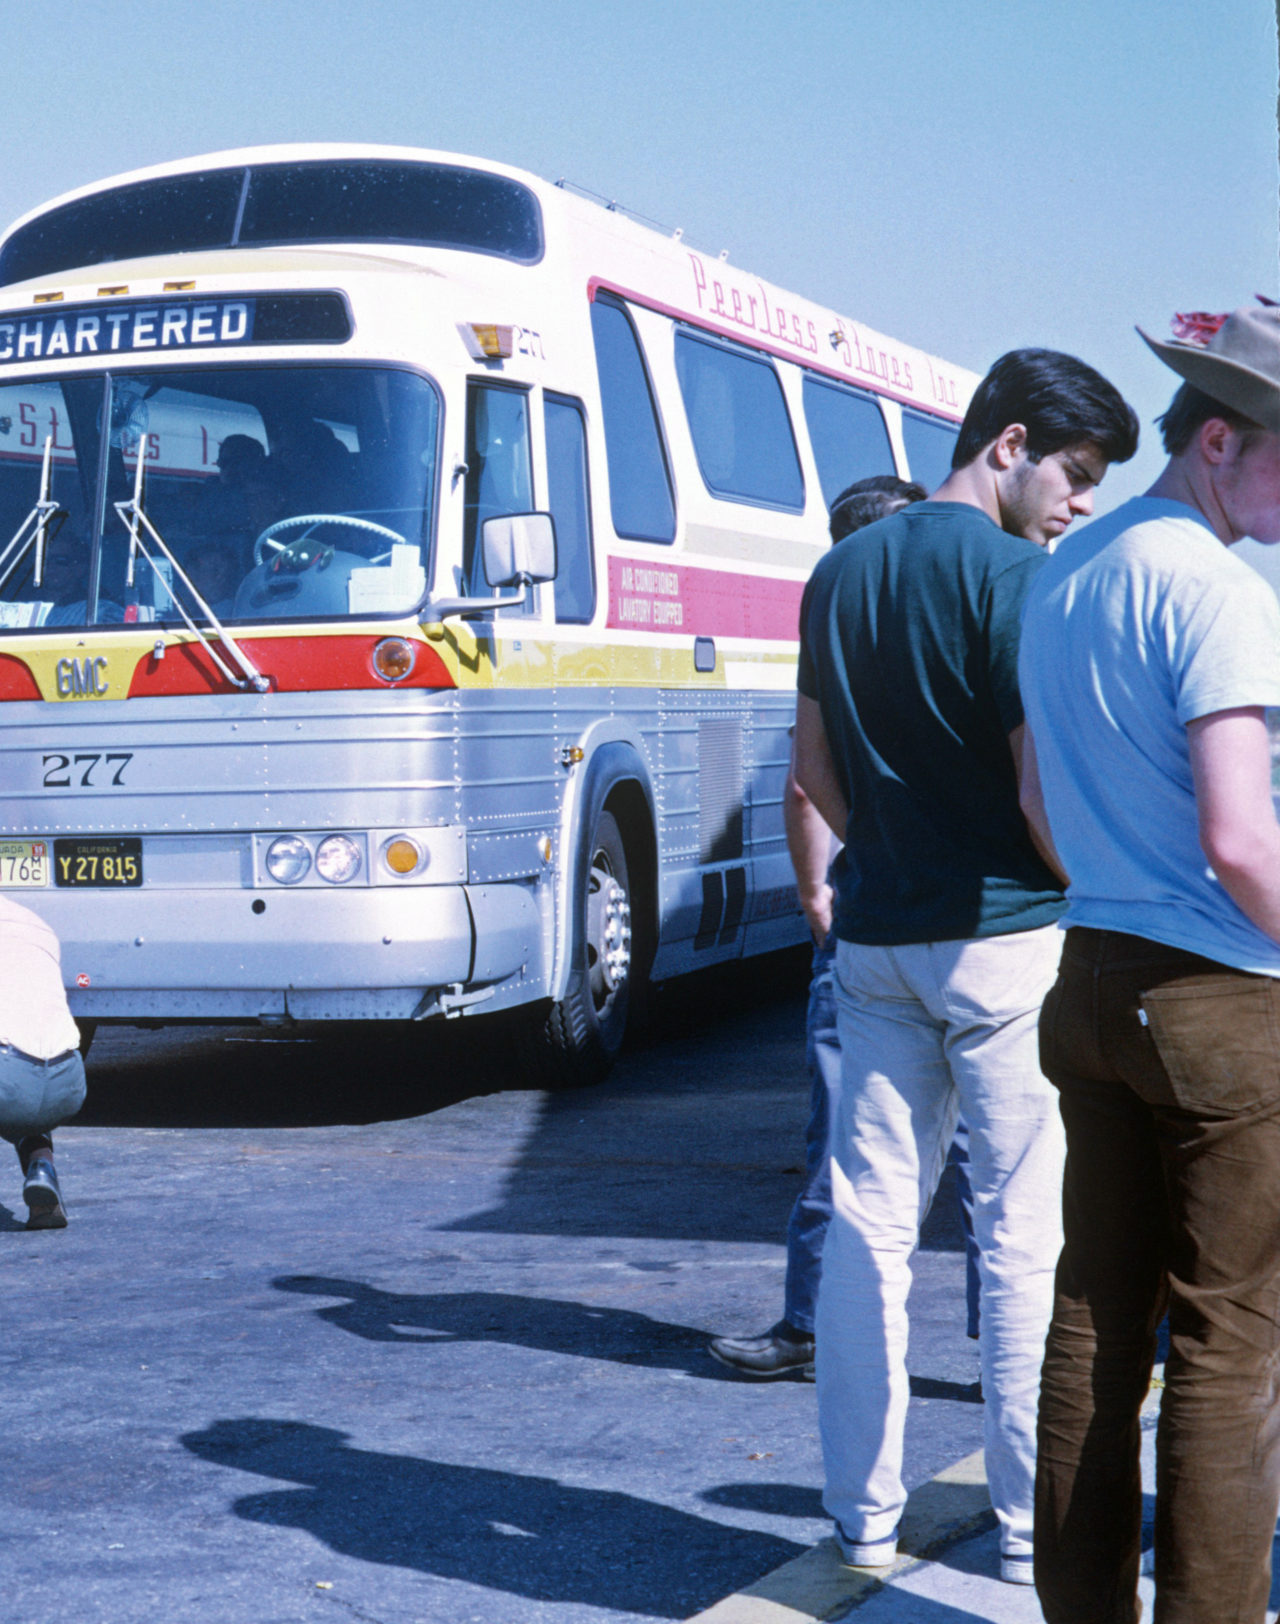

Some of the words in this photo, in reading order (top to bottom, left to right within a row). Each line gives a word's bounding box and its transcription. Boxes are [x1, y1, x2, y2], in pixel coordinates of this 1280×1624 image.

[687, 252, 818, 354] Peerless
[621, 566, 634, 591] AIR
[56, 656, 109, 695] GMC
[42, 753, 134, 788] 277
